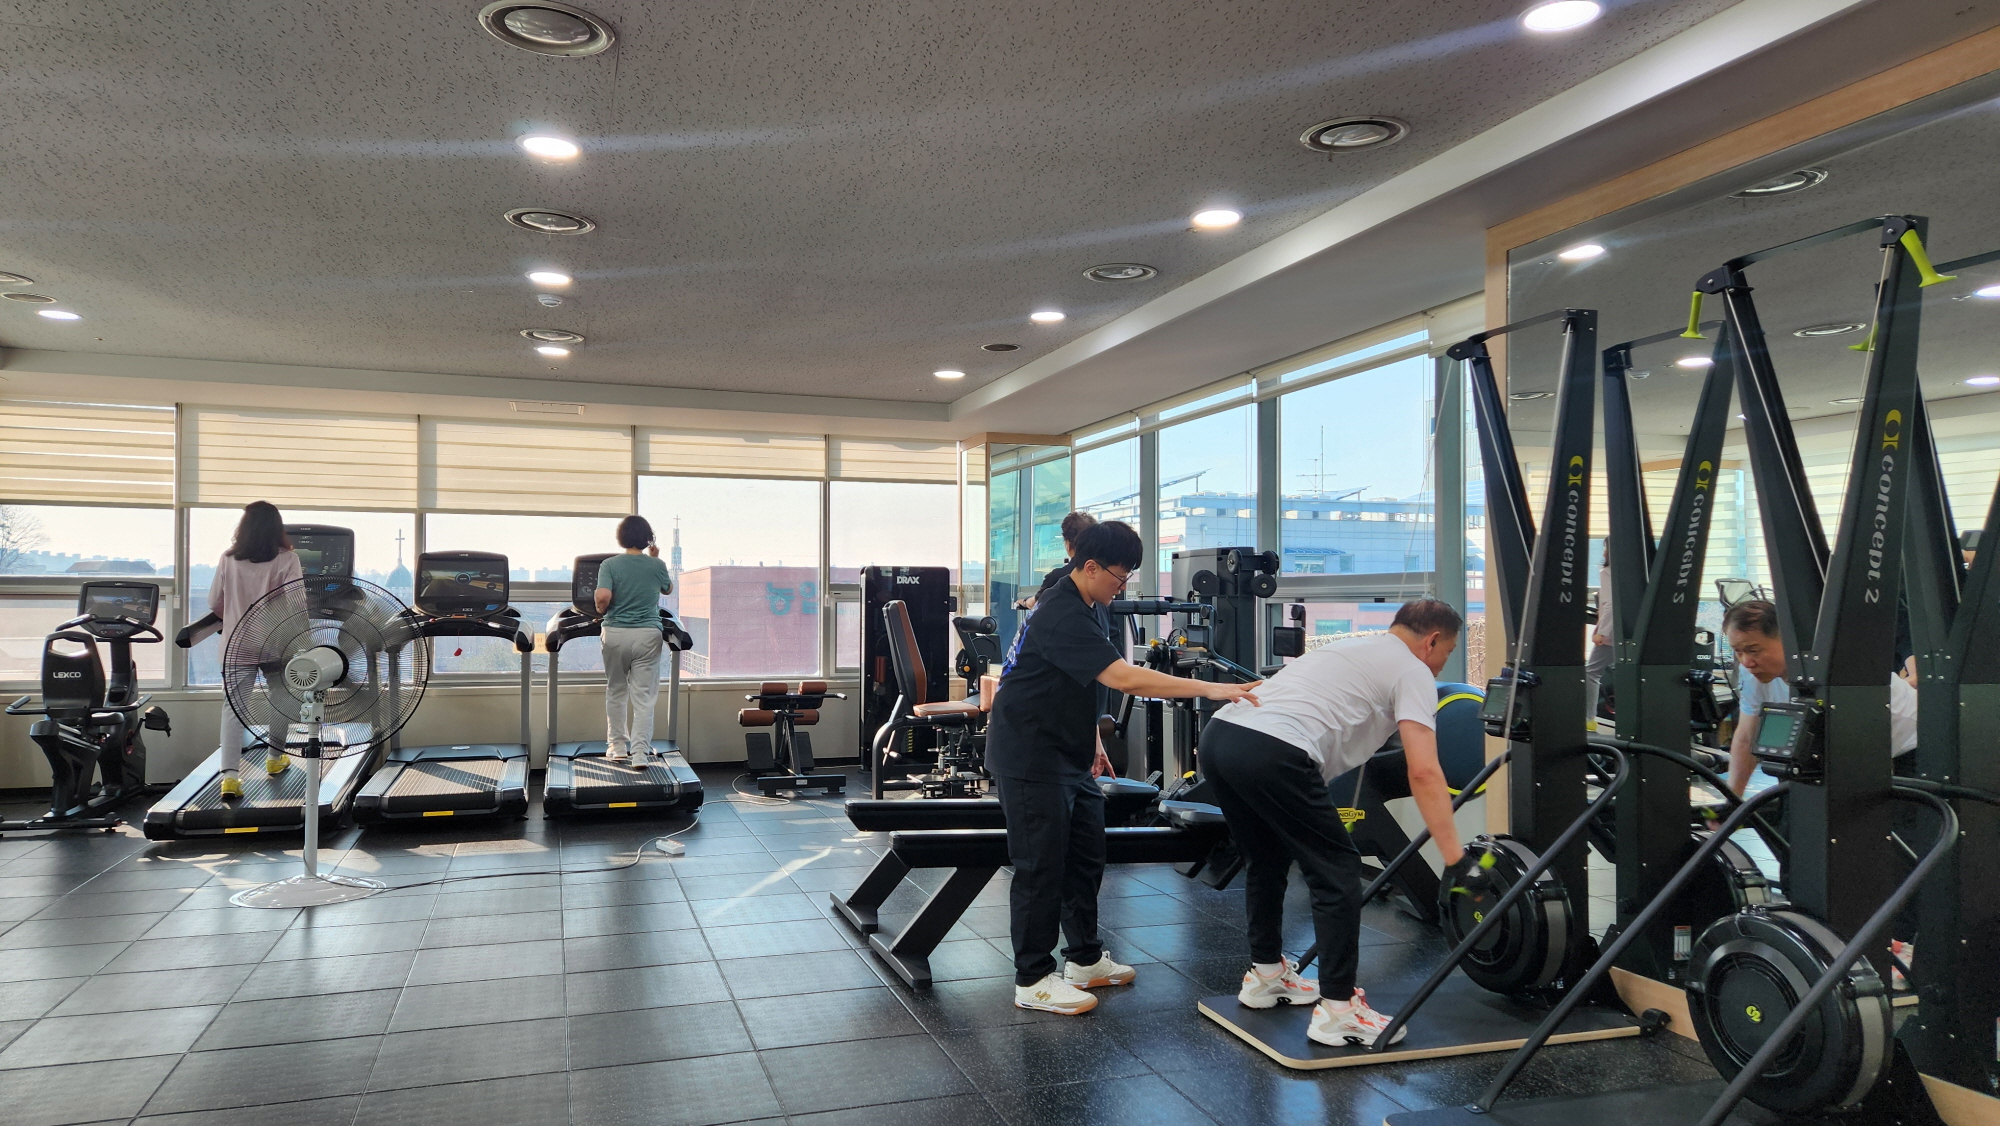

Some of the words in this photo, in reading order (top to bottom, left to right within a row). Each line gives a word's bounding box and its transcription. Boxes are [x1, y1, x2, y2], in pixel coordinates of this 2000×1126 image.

[1867, 454, 1895, 581] concept
[1562, 489, 1580, 586] concept
[896, 576, 920, 584] DRAX
[1559, 591, 1573, 604] 2
[1865, 588, 1880, 604] 2
[52, 671, 82, 679] LEXCO
